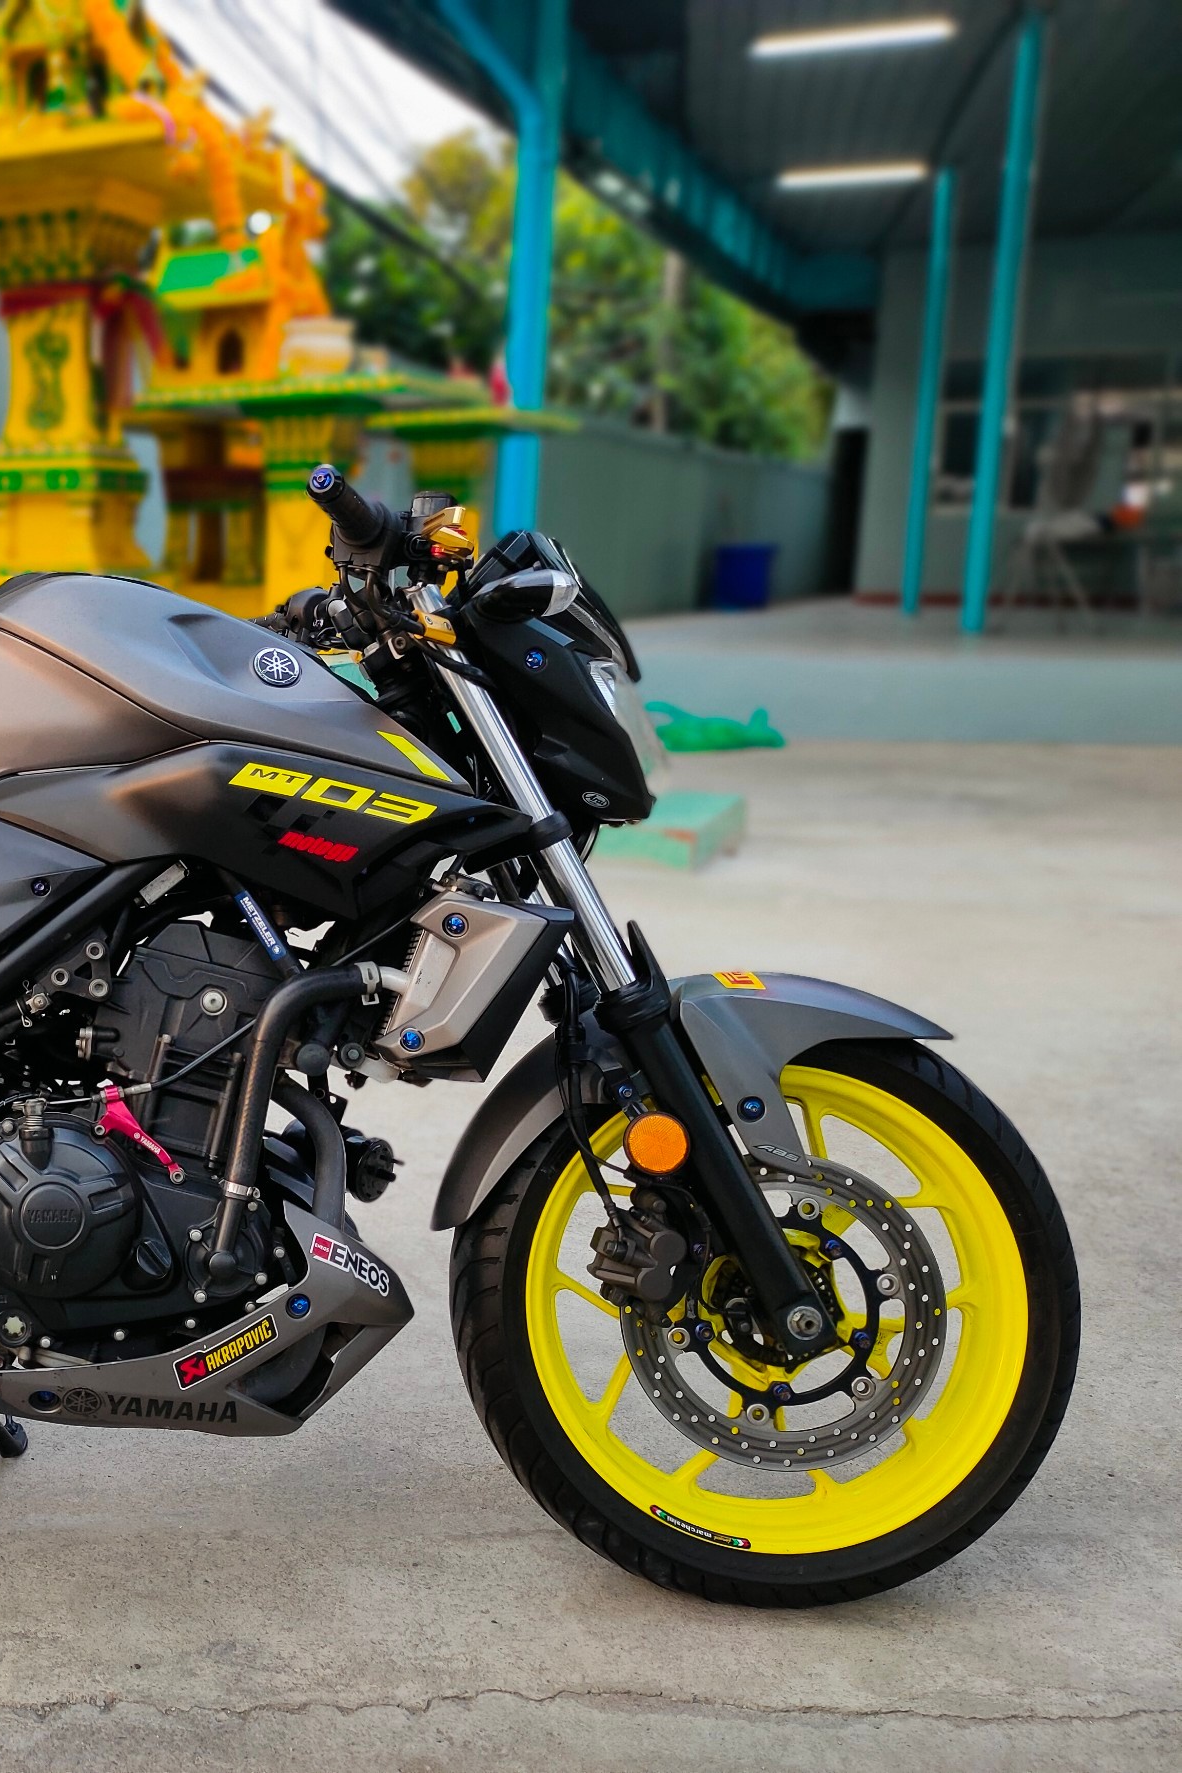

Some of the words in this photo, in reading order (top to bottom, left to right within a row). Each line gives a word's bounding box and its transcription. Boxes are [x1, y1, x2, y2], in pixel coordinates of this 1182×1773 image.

[249, 768, 305, 784] MT
[300, 777, 438, 825] 03
[242, 896, 276, 946] METZELER
[27, 1207, 77, 1224] YAMAHA
[329, 1242, 389, 1296] ENEOS
[107, 1394, 238, 1423] YAMAHA
